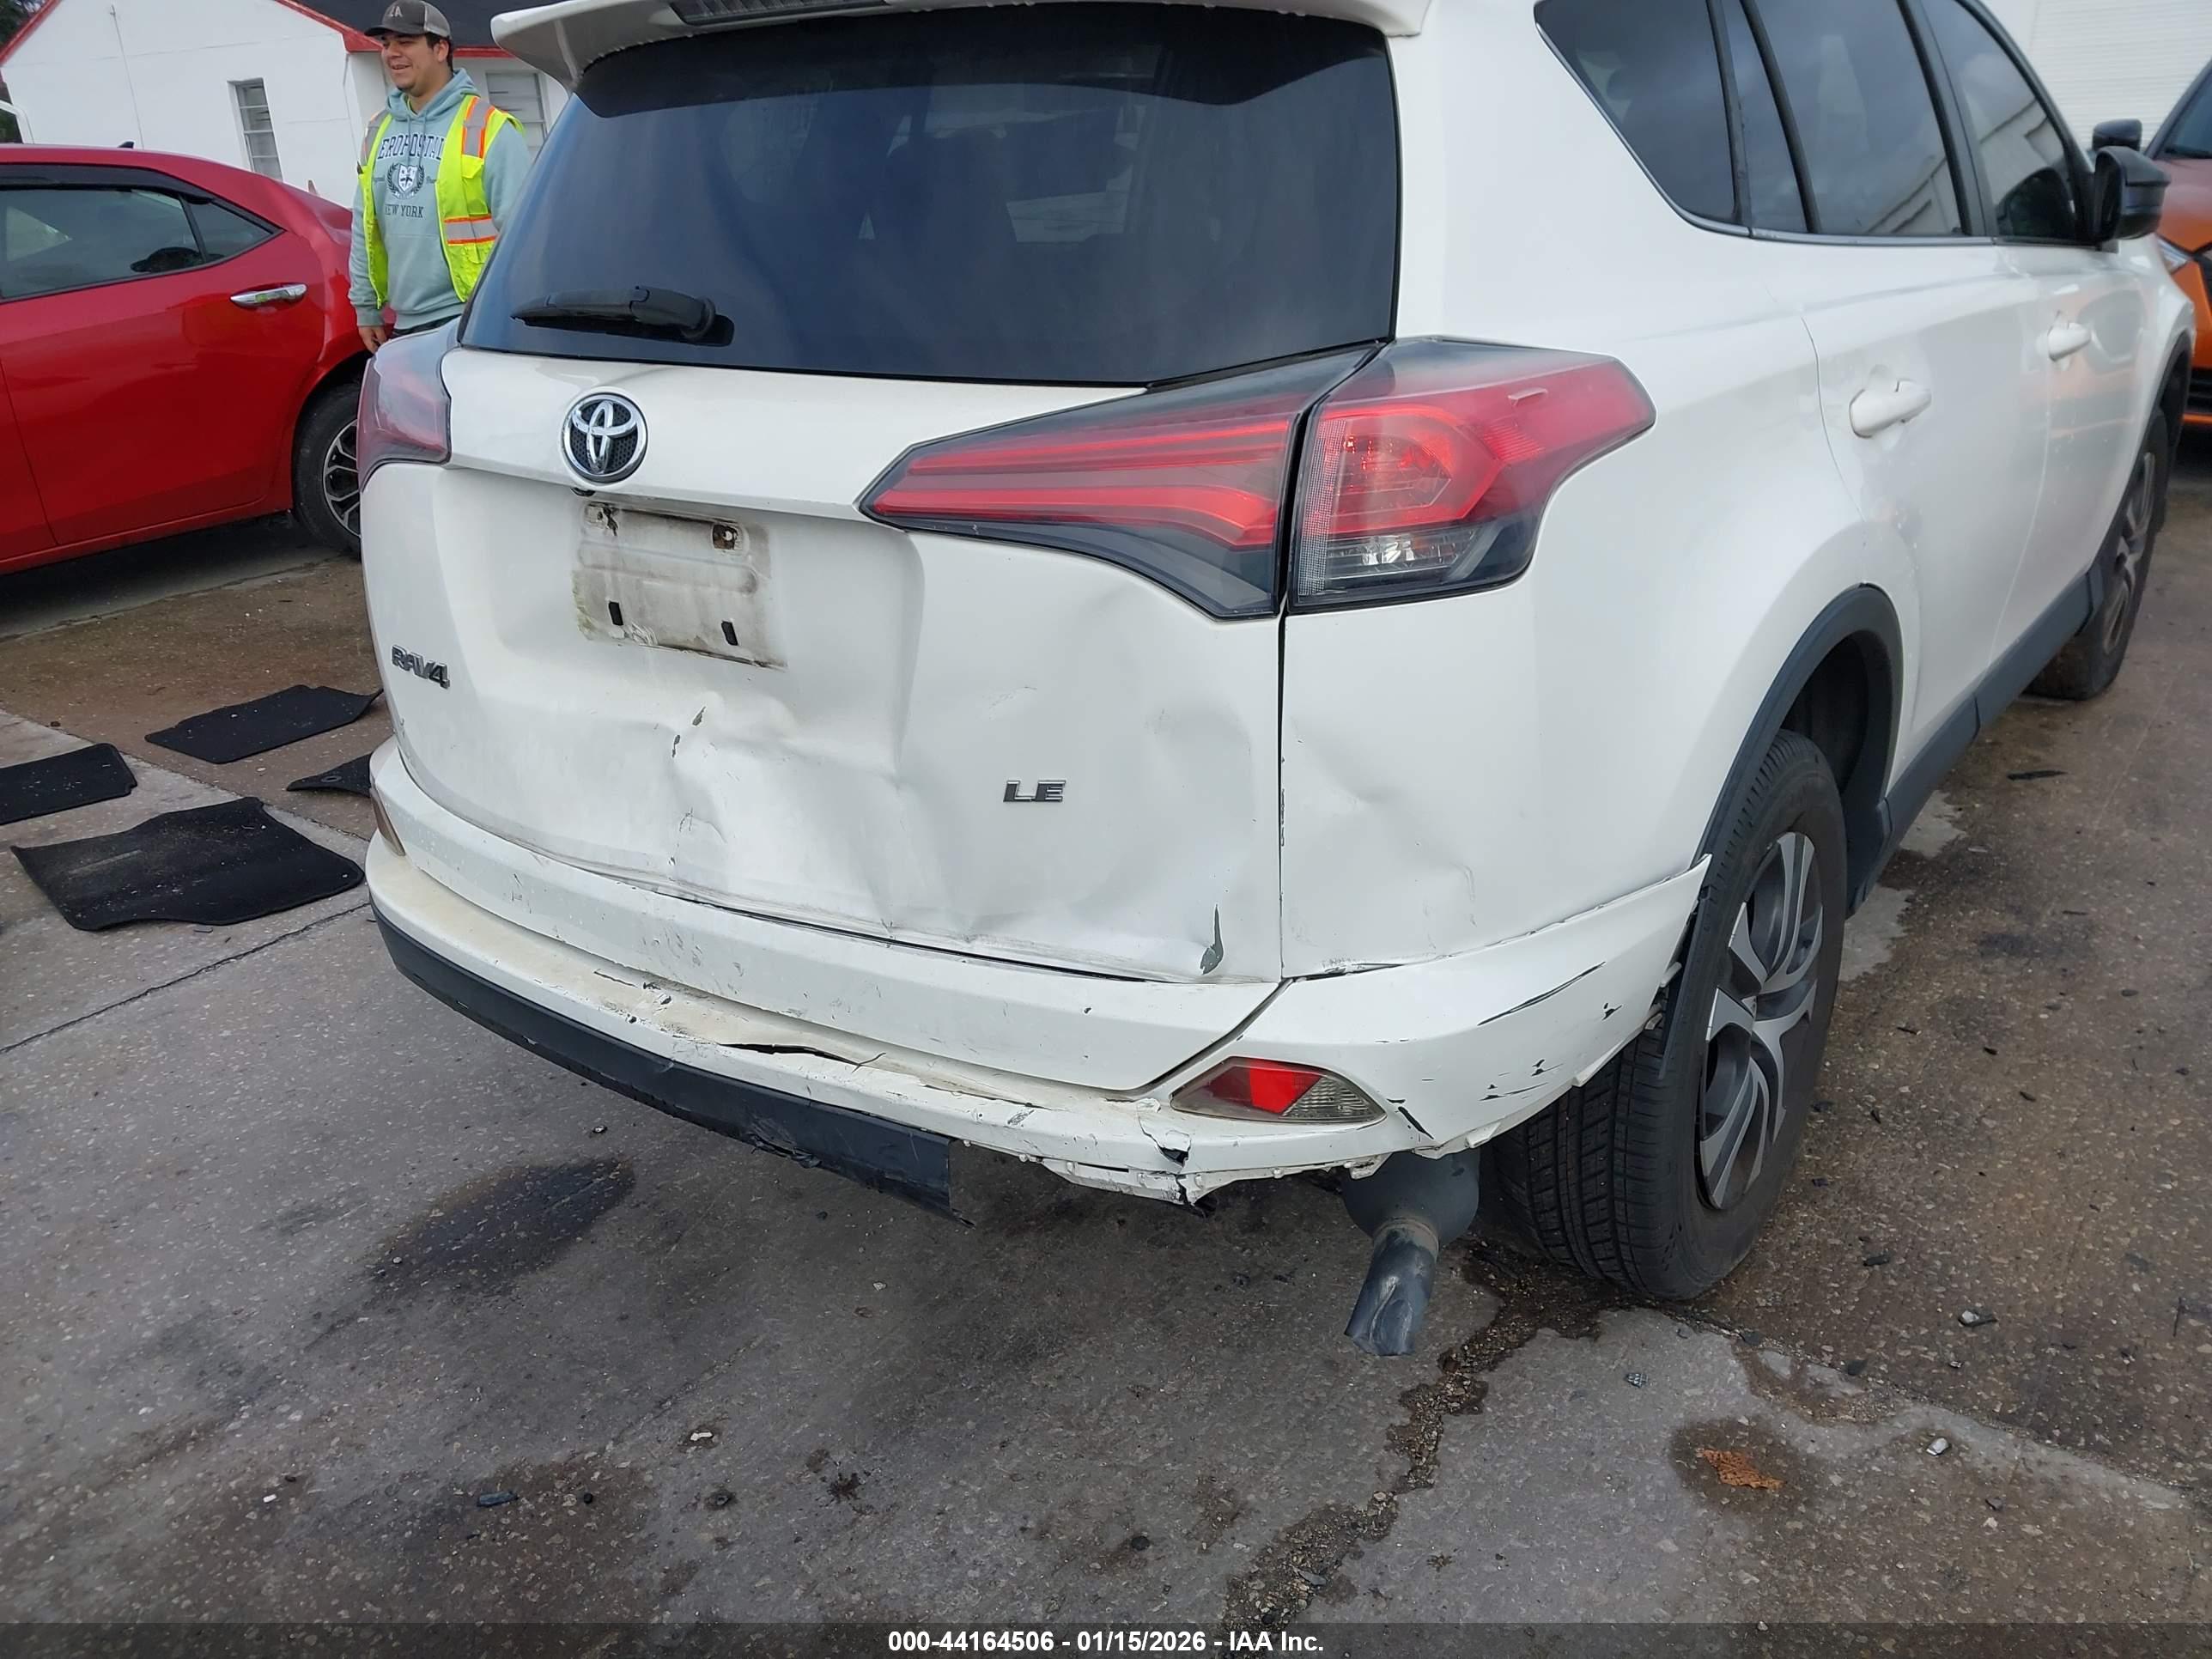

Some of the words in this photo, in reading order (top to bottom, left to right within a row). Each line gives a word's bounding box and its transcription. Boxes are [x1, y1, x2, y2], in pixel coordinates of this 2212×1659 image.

[378, 134, 444, 161] EROPOSTAL
[385, 204, 399, 216] EW
[401, 204, 424, 218] YORK
[392, 645, 450, 690] RAV4
[1003, 780, 1066, 803] LE
